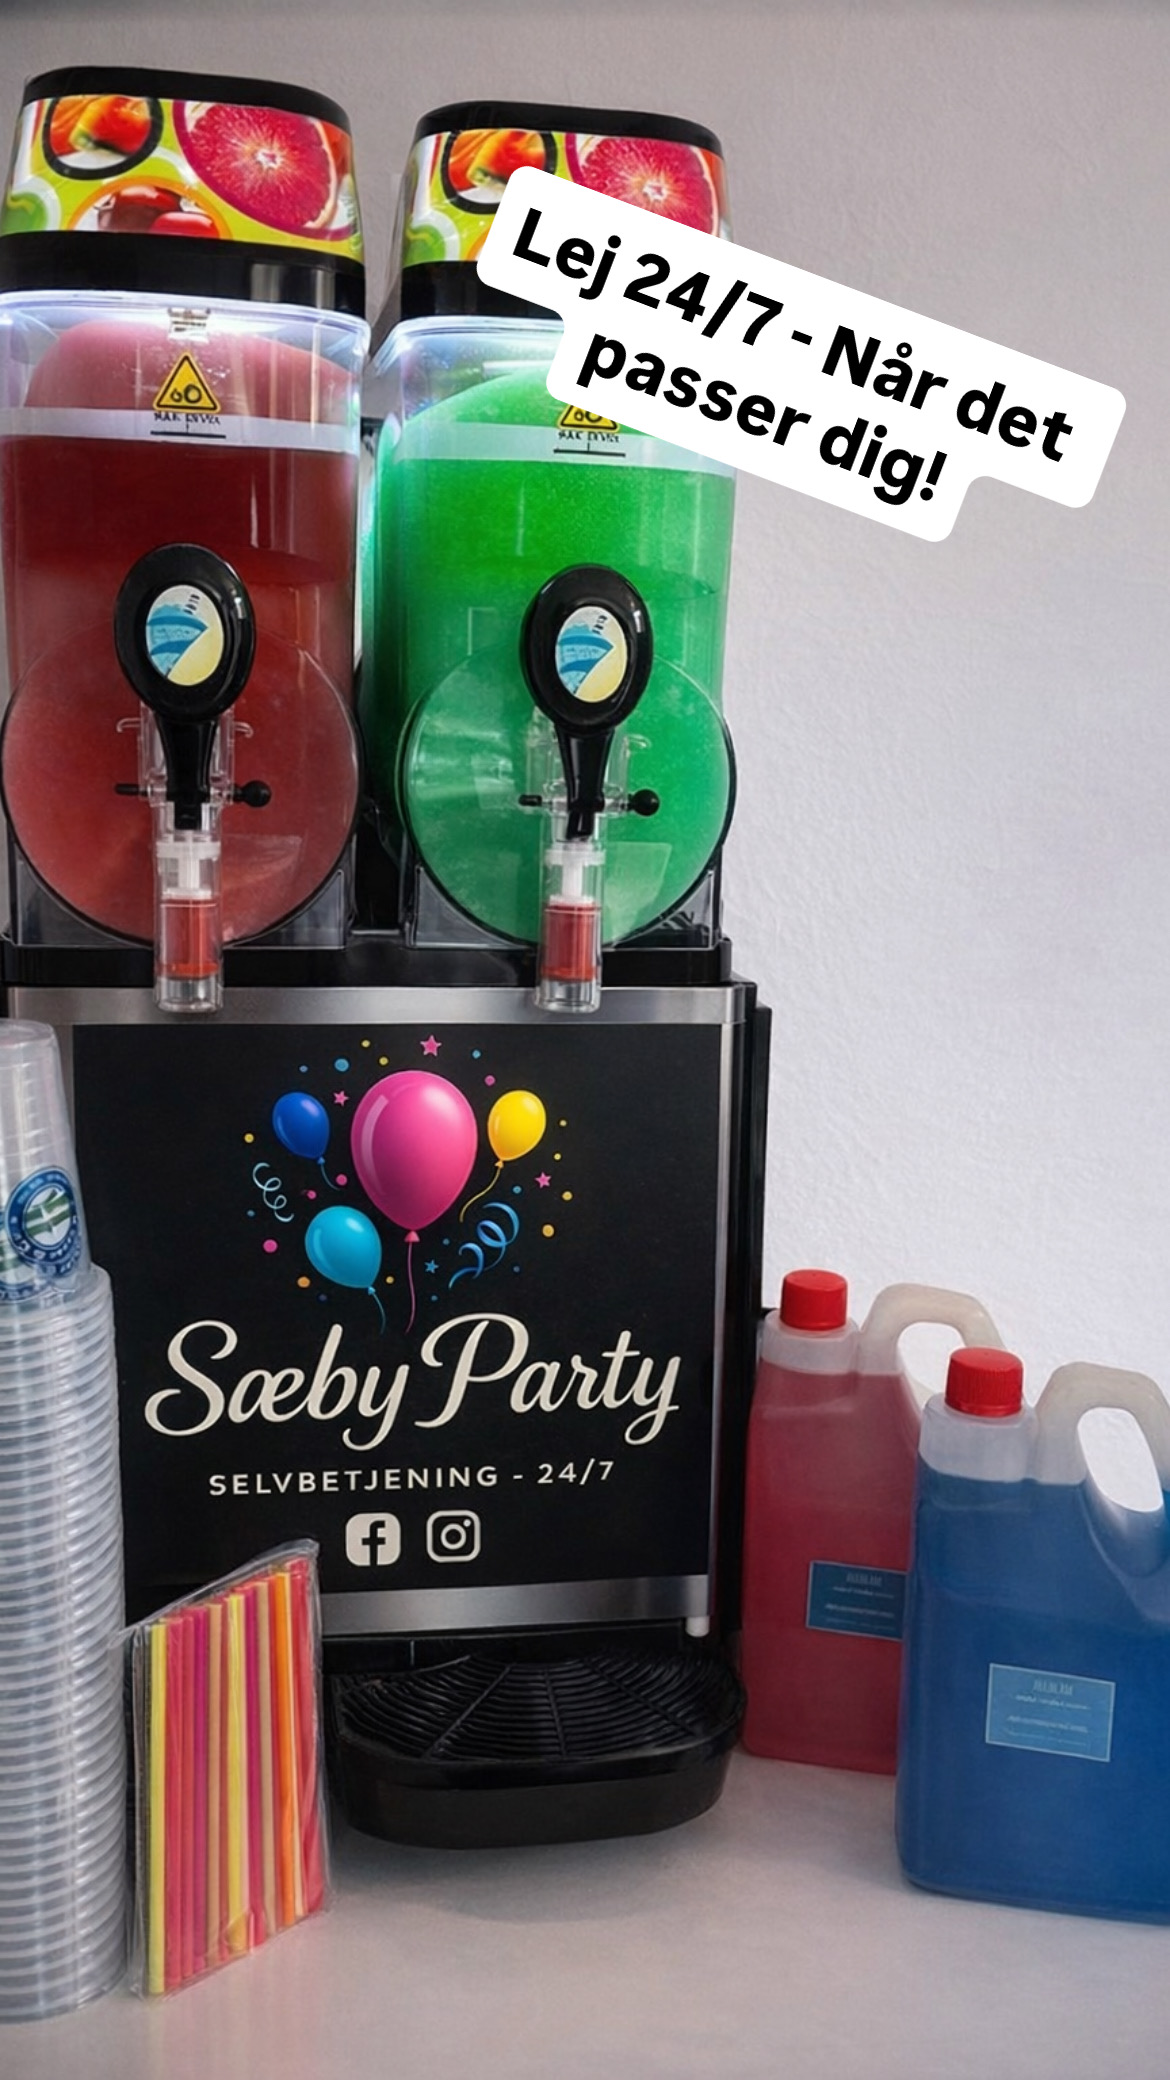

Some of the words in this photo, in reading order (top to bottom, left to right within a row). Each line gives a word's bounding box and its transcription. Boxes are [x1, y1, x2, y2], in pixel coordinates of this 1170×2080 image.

[145, 1320, 410, 1450] Sæby
[414, 1313, 681, 1445] Party
[209, 1465, 497, 1496] SELVBETJENING
[537, 1458, 614, 1485] 24/7
